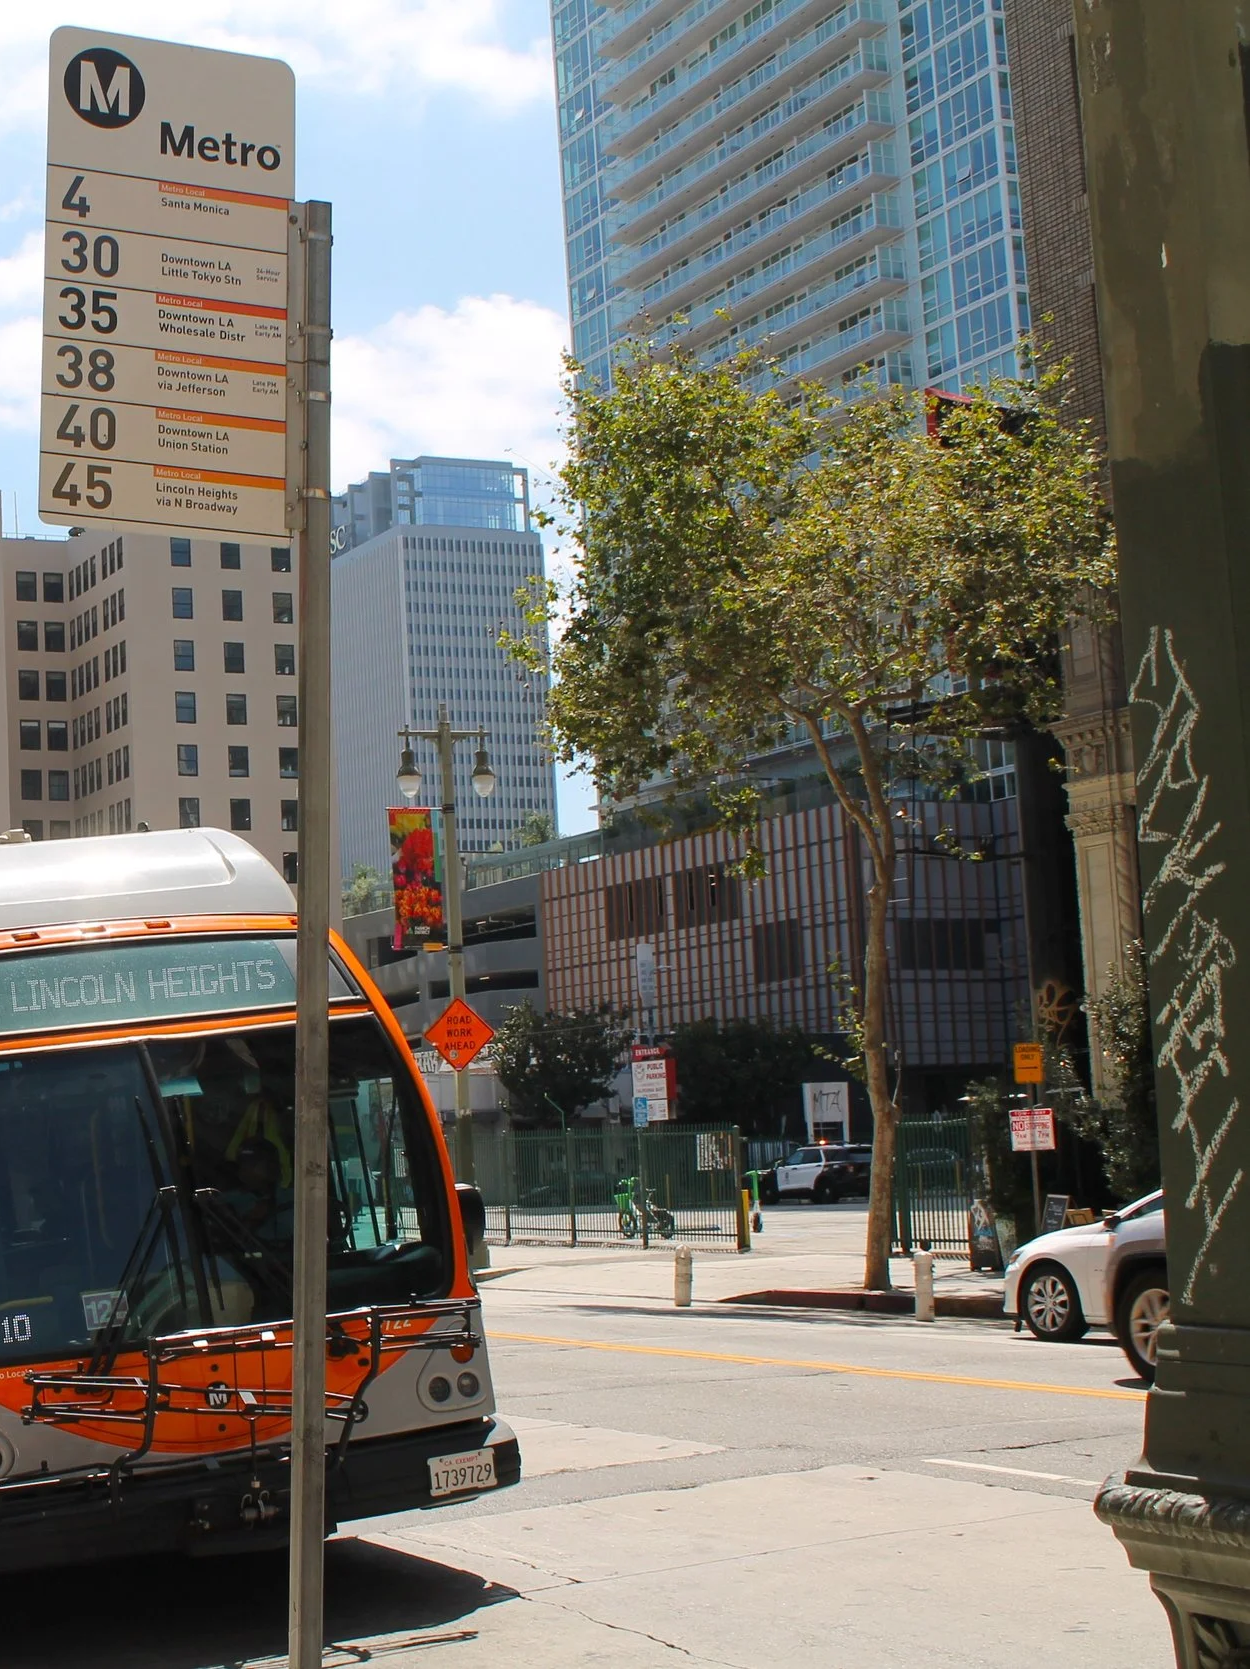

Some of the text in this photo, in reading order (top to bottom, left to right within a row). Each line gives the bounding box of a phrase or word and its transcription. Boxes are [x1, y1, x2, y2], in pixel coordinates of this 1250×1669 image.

[79, 60, 130, 117] M
[160, 121, 281, 171] Metro
[62, 175, 90, 218] 4
[161, 184, 205, 197] Metro Local
[161, 198, 230, 215] Santa Monica
[61, 231, 119, 278] 30
[161, 253, 231, 271] Downtown LA
[161, 266, 241, 286] Little Tokyo Stn
[59, 287, 118, 334] 35
[158, 296, 202, 308] Metro Local
[158, 309, 234, 328] Downtown LA
[159, 322, 246, 342] Wholesale Distr
[255, 331, 270, 339] Early
[157, 353, 202, 365] Metro Local
[56, 345, 115, 392] 38
[158, 366, 229, 384] Downtown LA
[158, 381, 226, 397] via Jefferson
[252, 387, 268, 395] Early
[158, 410, 202, 422] Metro Local
[57, 404, 116, 451] 40
[158, 424, 229, 441] Downtown LA
[158, 438, 228, 454] Union Station
[156, 468, 201, 480] Metro Local
[52, 462, 112, 510] 45
[156, 482, 238, 500] Lincoln Heights
[156, 496, 238, 515] via N Broadway
[11, 971, 136, 1013] LINCOLN
[148, 959, 277, 1001] HEIGHTS
[446, 1016, 472, 1024] ROAD
[447, 1028, 472, 1037] WORK
[444, 1041, 475, 1051] AHEAD
[1012, 1121, 1024, 1131] NO
[1, 1314, 32, 1344] 10
[455, 1455, 478, 1464] EXEMPT
[434, 1463, 492, 1490] 1739729
